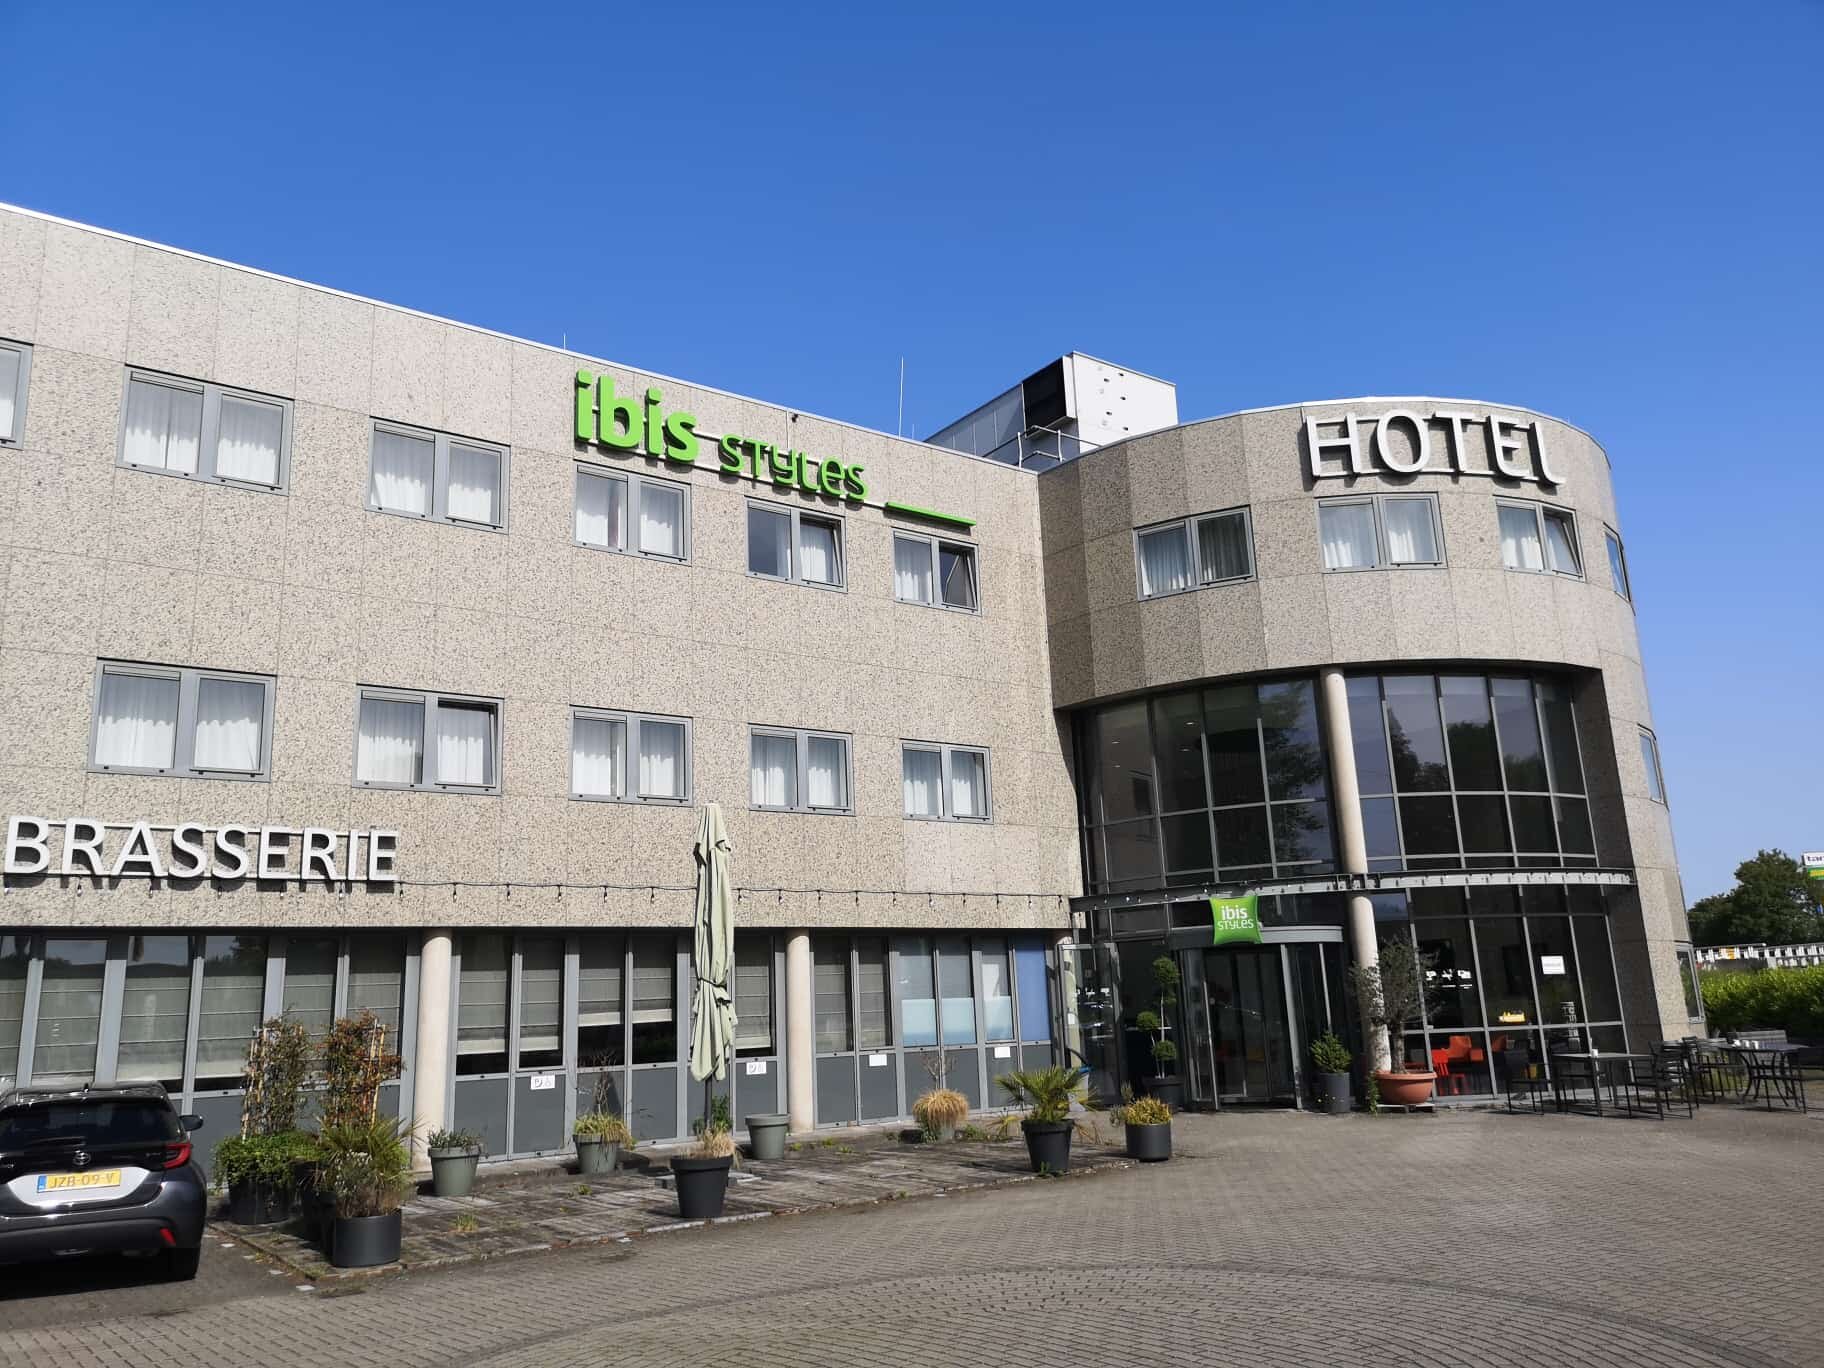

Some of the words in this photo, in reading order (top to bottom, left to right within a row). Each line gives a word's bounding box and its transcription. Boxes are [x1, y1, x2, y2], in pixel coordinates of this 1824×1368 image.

[575, 369, 700, 463] ibis
[1306, 408, 1566, 486] HOTEL
[4, 815, 400, 881] BRASSERIE
[1221, 905, 1248, 920] ibis
